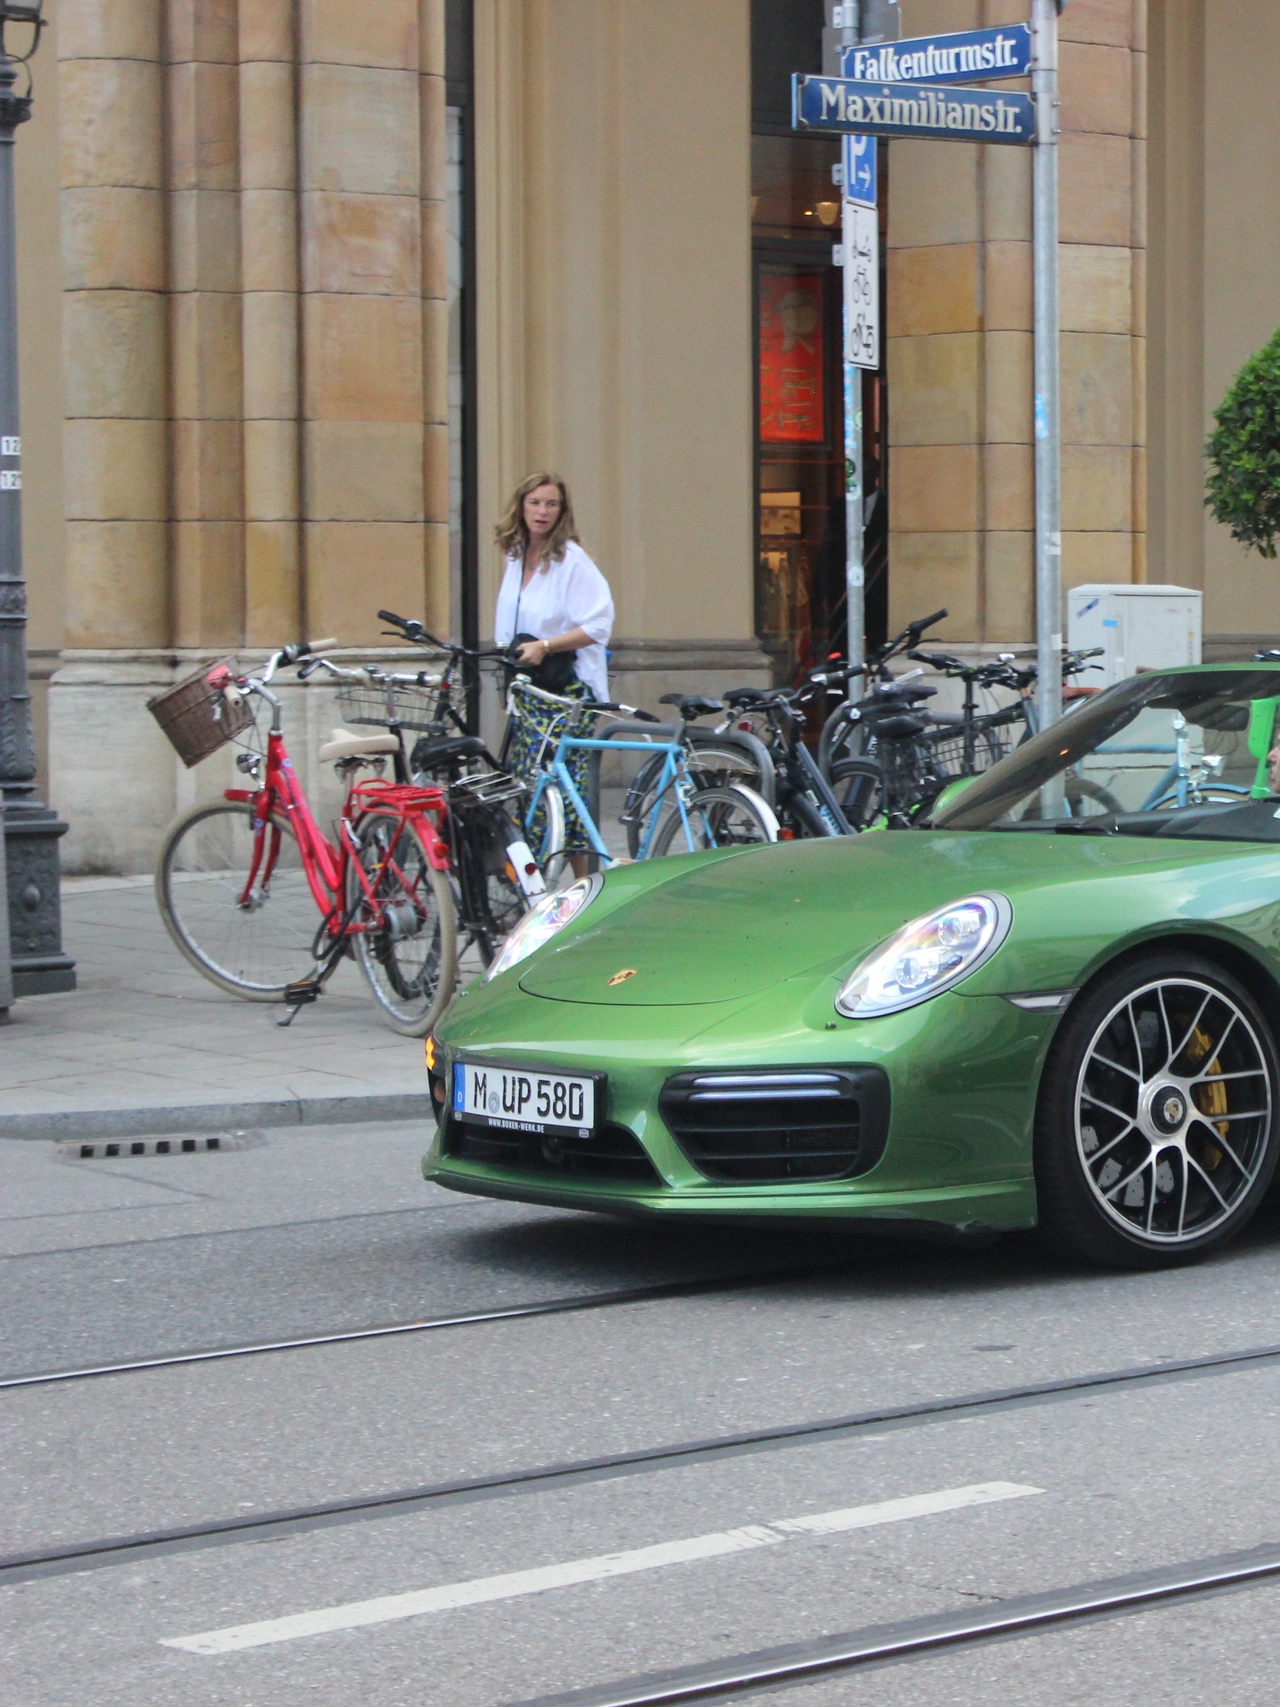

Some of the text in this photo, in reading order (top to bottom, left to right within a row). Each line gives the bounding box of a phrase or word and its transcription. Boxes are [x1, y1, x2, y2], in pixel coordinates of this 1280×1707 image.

[854, 34, 1019, 80] Falkenturmstr.
[820, 83, 1023, 133] Maximilianstr.
[474, 1071, 584, 1121] M UP 580
